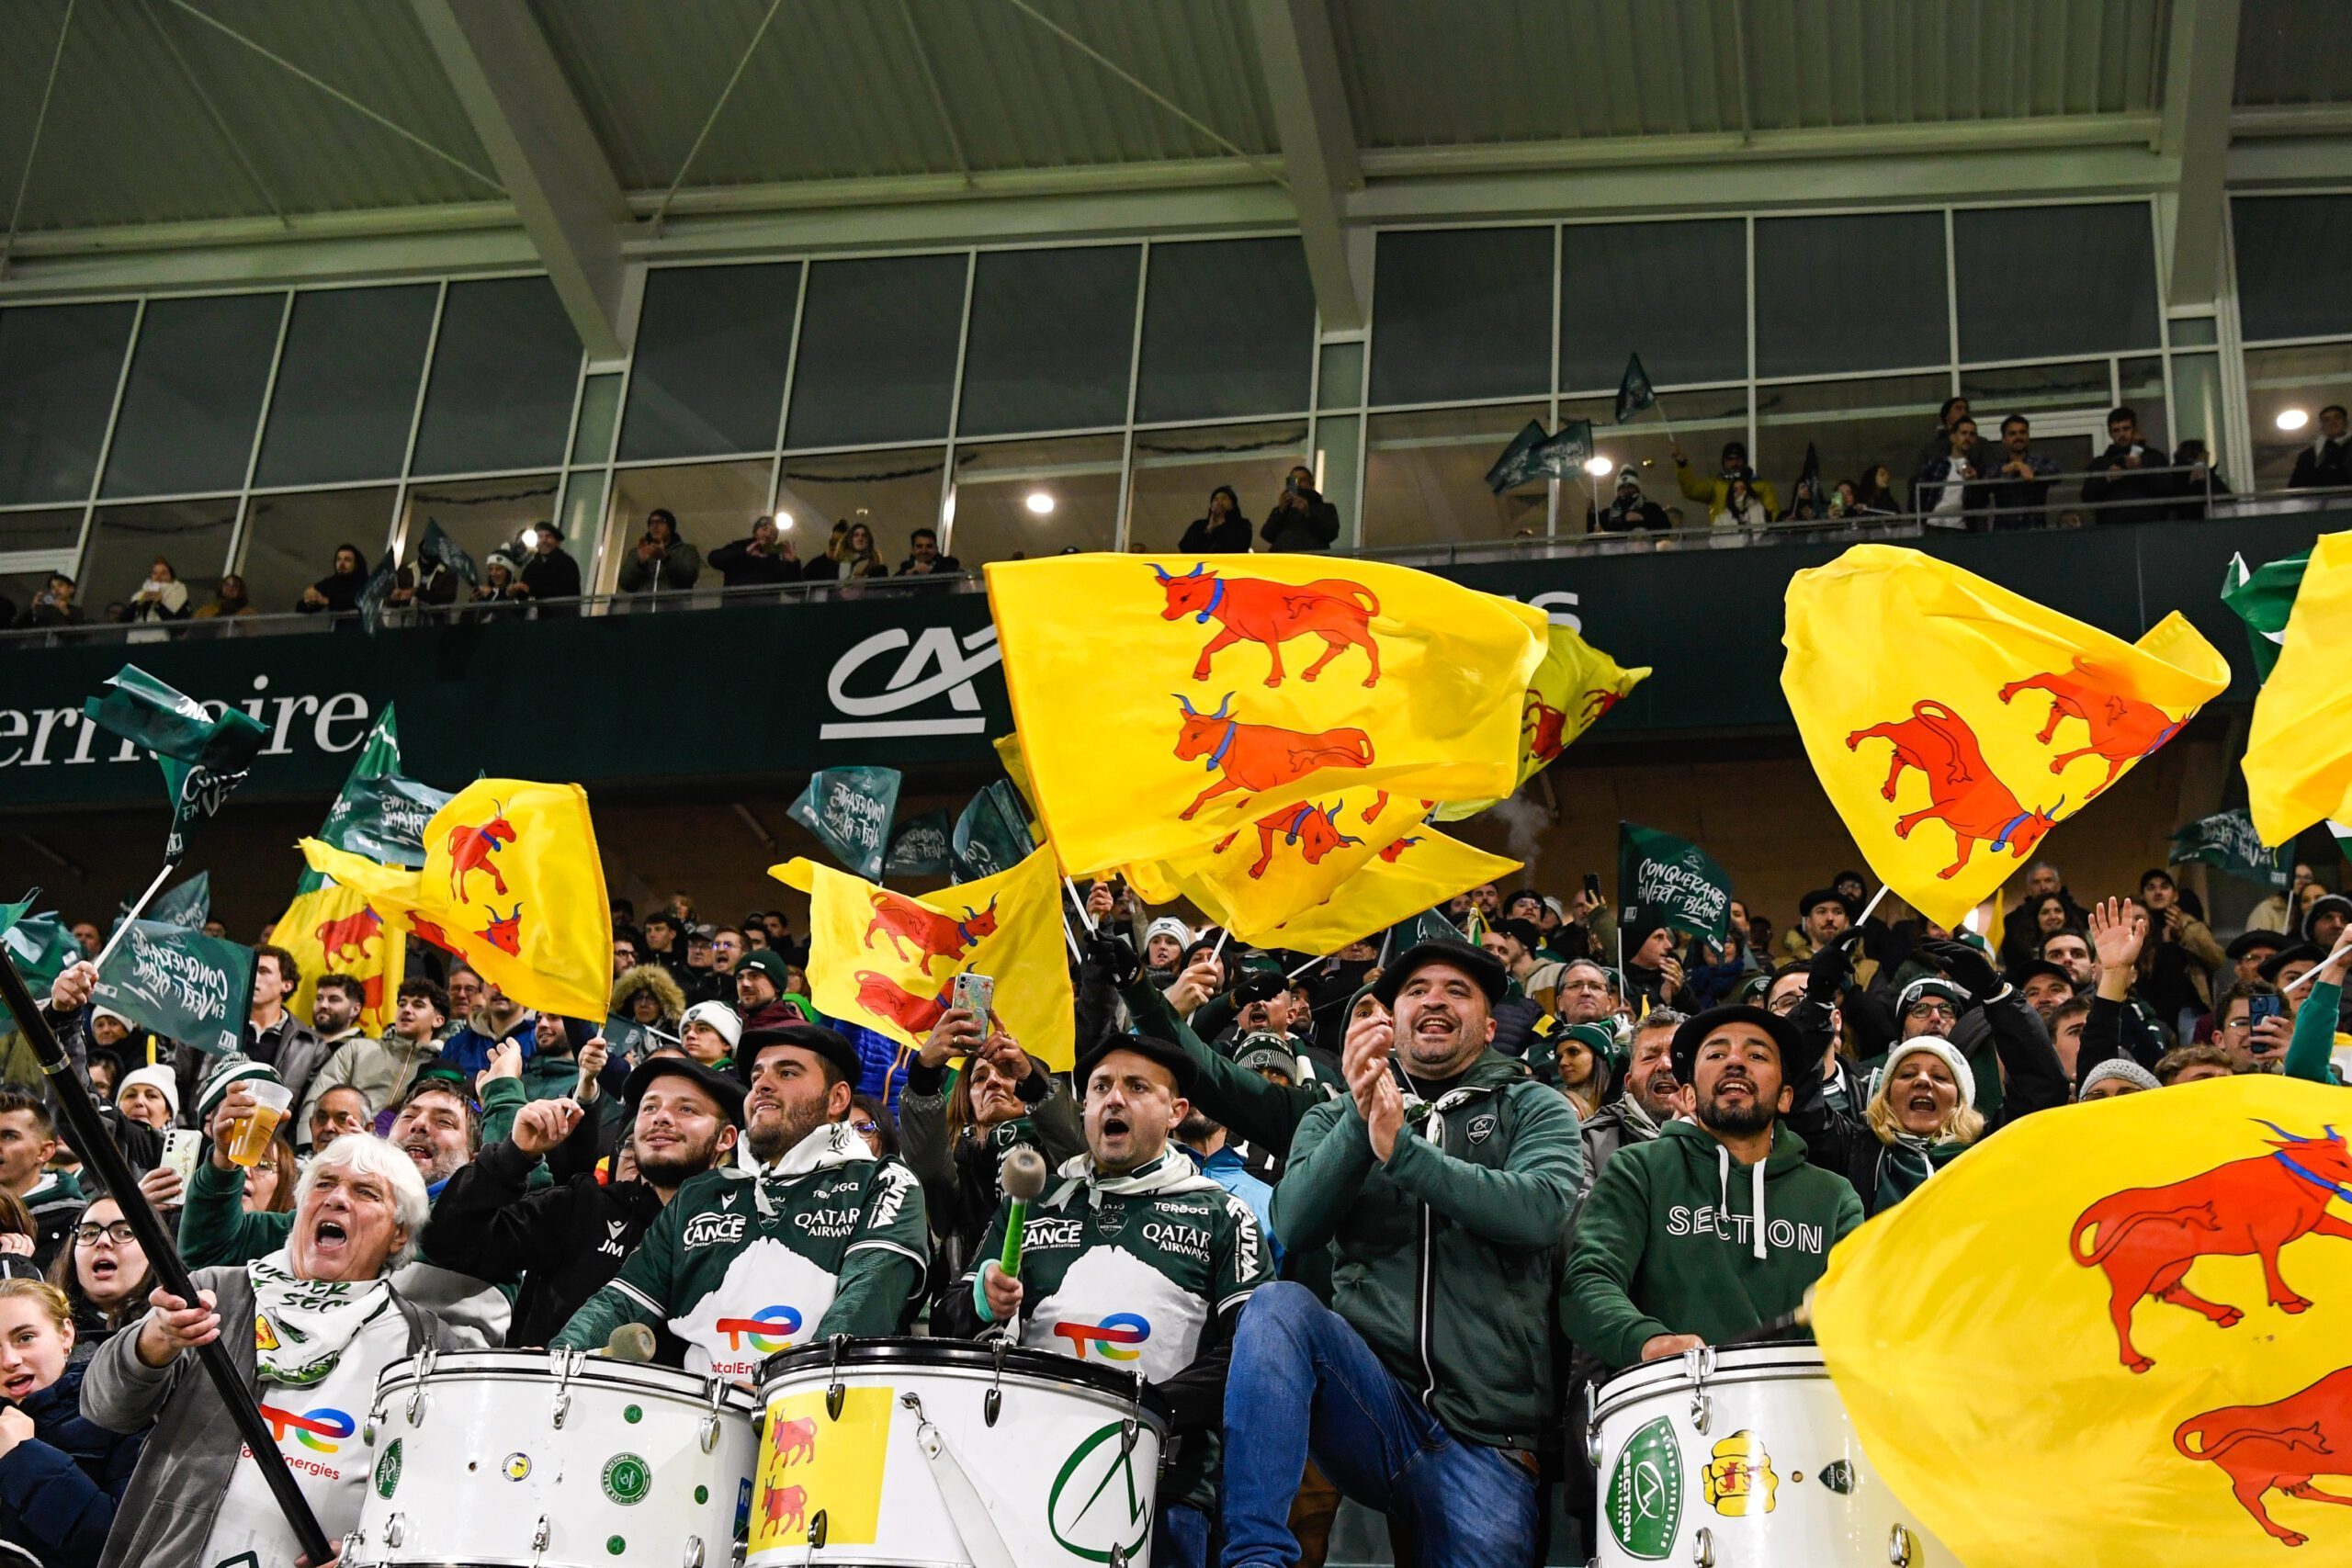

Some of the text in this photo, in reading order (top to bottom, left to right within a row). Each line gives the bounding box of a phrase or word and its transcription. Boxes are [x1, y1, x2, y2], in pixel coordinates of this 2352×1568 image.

[1638, 858, 1727, 910] CONQUERANTS
[1645, 878, 1686, 905] VERT
[1682, 894, 1721, 922] BLANC
[794, 1208, 861, 1229] QATAR
[808, 1225, 854, 1238] AIRWAY
[1666, 1205, 1823, 1255] SECTON
[597, 1238, 625, 1258] JM
[1142, 1224, 1212, 1251] QATAR
[1159, 1240, 1211, 1264] AIRWAYS
[1623, 1450, 1631, 1543] SECTION
